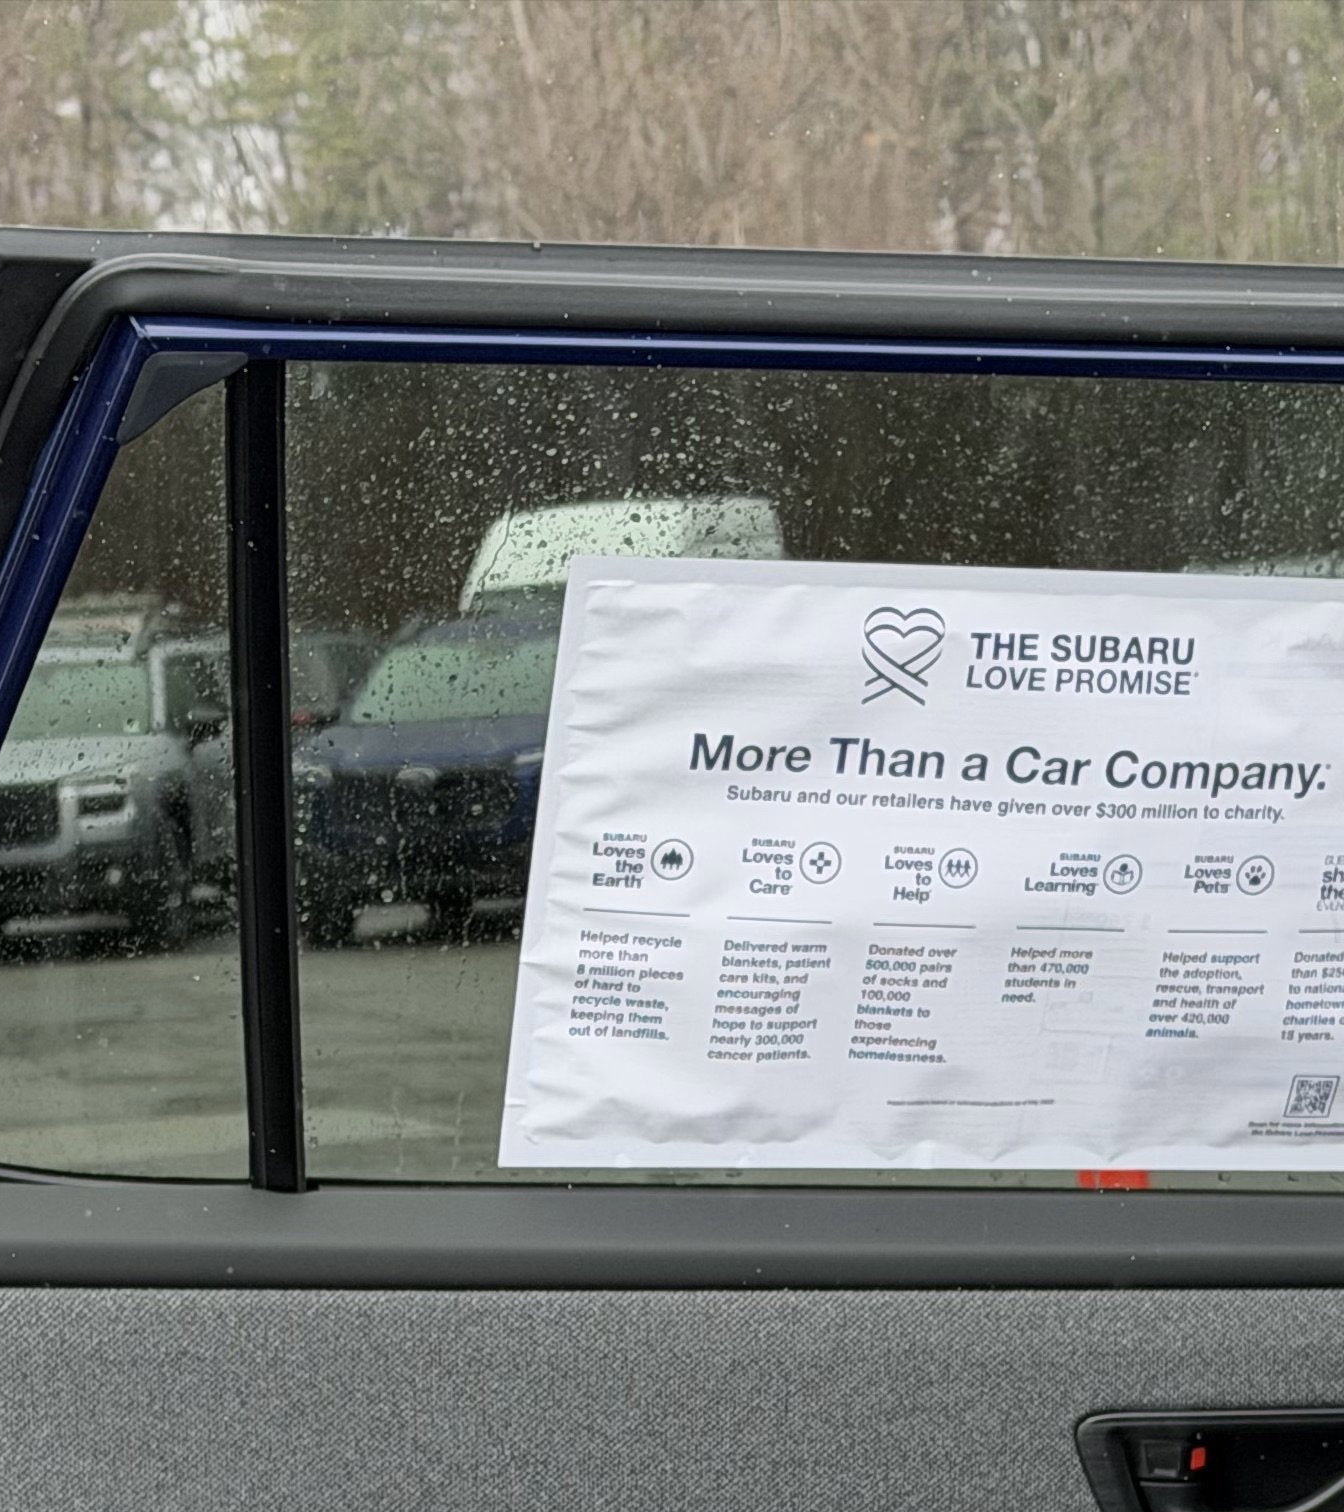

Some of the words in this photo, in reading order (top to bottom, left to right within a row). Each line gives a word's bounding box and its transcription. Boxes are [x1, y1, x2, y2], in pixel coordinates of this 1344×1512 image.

[971, 633, 1039, 661] THE
[1051, 634, 1194, 665] SUBARU
[966, 665, 1046, 691] LOVE
[690, 733, 811, 772] More
[830, 737, 944, 779] Than
[961, 754, 988, 781] a
[1006, 746, 1091, 785] Car
[727, 785, 792, 802] Subaru
[797, 789, 831, 804] and
[836, 793, 867, 806] our
[872, 793, 944, 809] retailers
[950, 795, 992, 812] have
[998, 798, 1046, 817] given
[1052, 804, 1091, 816] over
[1096, 802, 1137, 819] $300
[1141, 804, 1198, 819] million
[1204, 805, 1219, 819] to
[1224, 806, 1284, 824] charity.
[593, 842, 645, 859] Loves
[742, 848, 793, 865] Loves
[616, 860, 643, 874] the
[885, 855, 933, 871] Loves
[1050, 862, 1098, 877] Loves
[775, 867, 792, 880] to
[1184, 865, 1231, 879] Loves
[916, 873, 932, 886] to
[581, 930, 629, 945] Helped
[633, 936, 682, 949] recycle
[724, 940, 788, 953] Delivered
[791, 944, 827, 953] warm
[579, 950, 614, 960] more
[619, 950, 648, 962] than
[869, 944, 925, 957] Donated
[928, 948, 957, 958] over
[1011, 947, 1057, 960] Helped
[1059, 950, 1093, 959] more
[1294, 951, 1344, 963] Donated
[722, 956, 781, 970] blankets,
[785, 958, 831, 970] patient
[1163, 952, 1207, 965] Helped
[1211, 953, 1260, 965] support
[576, 964, 585, 975] 8
[589, 965, 635, 978] million
[639, 968, 683, 981] pieces
[865, 959, 916, 972] 500,000
[919, 962, 952, 975] pairs
[1008, 962, 1036, 972] than
[1160, 967, 1179, 978] the
[1183, 968, 1242, 981] adoption,
[1291, 968, 1317, 979] than
[574, 978, 589, 988] of
[592, 979, 624, 991] hard
[627, 982, 641, 993] to
[719, 974, 748, 983] care
[753, 973, 779, 985] kits,
[783, 973, 809, 984] and
[862, 974, 877, 985] of
[880, 976, 918, 987] socks
[922, 977, 948, 988] and
[1005, 977, 1060, 988] students
[1064, 978, 1076, 989] in
[717, 989, 801, 1002] encouraging
[861, 989, 911, 1002] 100,000
[1156, 984, 1202, 995] rescue,
[1206, 984, 1264, 997] transport
[1289, 984, 1301, 994] to
[572, 995, 621, 1007] recycle
[625, 998, 669, 1011] waste,
[1001, 992, 1036, 1003] need.
[1153, 998, 1177, 1008] and
[1180, 998, 1219, 1009] health
[1223, 999, 1237, 1009] of
[570, 1008, 624, 1024] keeping
[629, 1012, 662, 1024] them
[715, 1005, 782, 1017] messages
[786, 1003, 800, 1014] of
[857, 1004, 913, 1017] blankets
[917, 1007, 930, 1018] to
[712, 1018, 746, 1032] hope
[750, 1020, 763, 1030] to
[767, 1019, 817, 1031] support
[855, 1019, 892, 1030] those
[1149, 1014, 1178, 1022] over
[1283, 1015, 1335, 1025] charities
[569, 1025, 590, 1036] out
[594, 1026, 608, 1037] of
[710, 1035, 752, 1048] nearly
[755, 1034, 804, 1046] 300,000
[849, 1035, 937, 1050] experiencing
[707, 1050, 753, 1060] cancer
[756, 1049, 811, 1063] patients.
[848, 1048, 946, 1063] homelessness.
